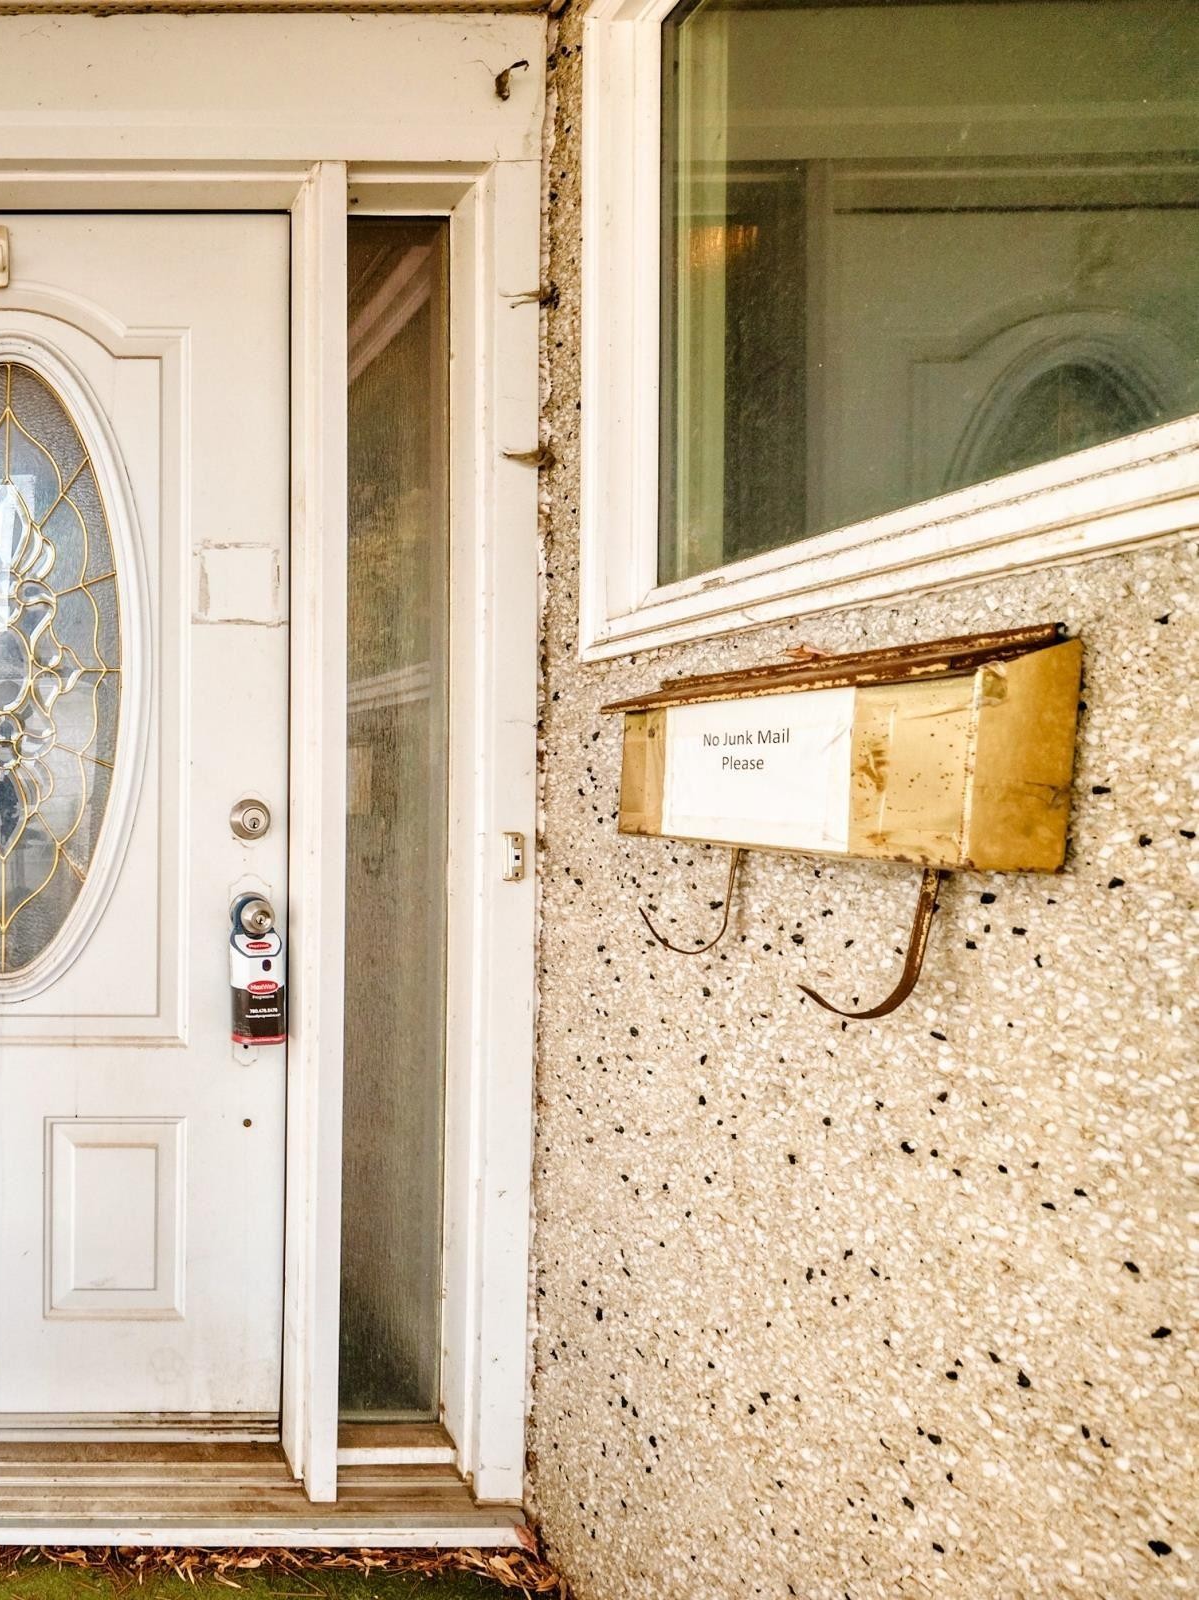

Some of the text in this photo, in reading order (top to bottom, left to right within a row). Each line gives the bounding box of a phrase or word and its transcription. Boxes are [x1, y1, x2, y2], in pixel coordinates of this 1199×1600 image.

[703, 728, 790, 747] No Junk Mail
[722, 755, 765, 770] Please
